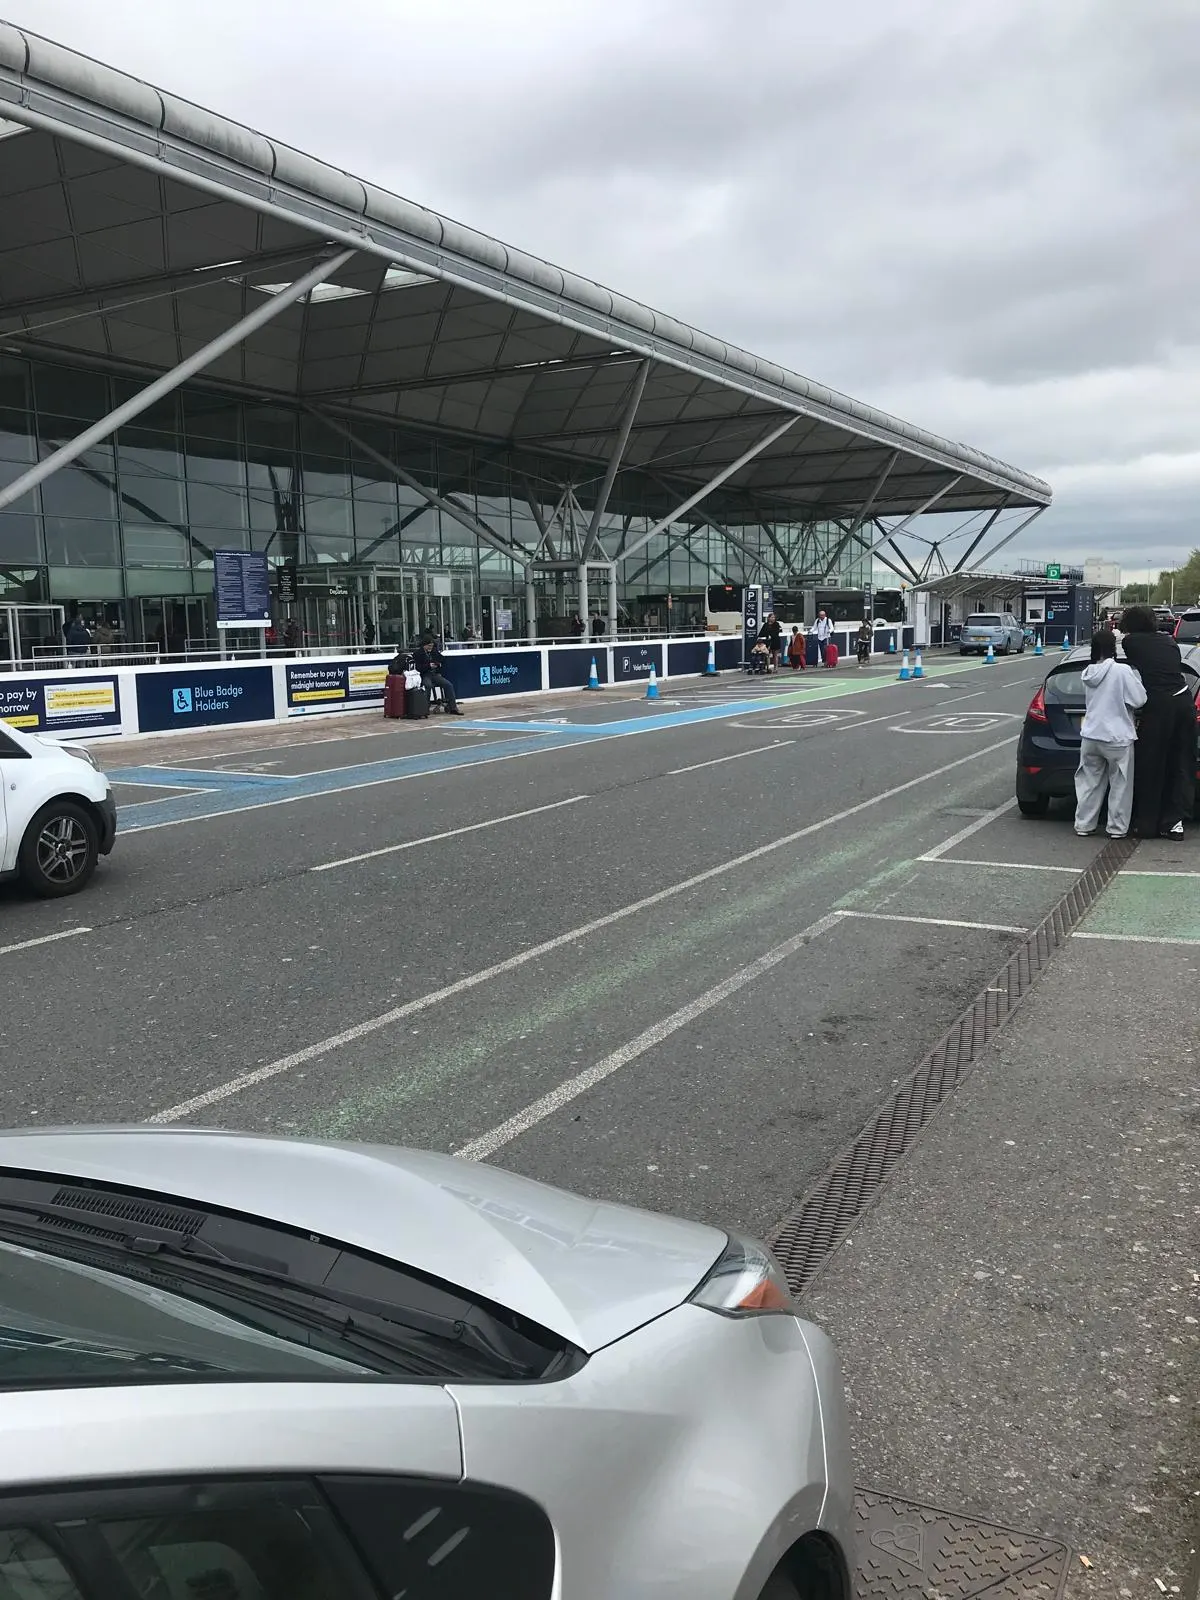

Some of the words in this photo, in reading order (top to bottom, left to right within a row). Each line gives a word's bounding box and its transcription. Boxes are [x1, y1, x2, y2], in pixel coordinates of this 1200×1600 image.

[1050, 569, 1058, 577] D
[747, 591, 755, 601] P
[491, 666, 503, 675] Blue
[503, 665, 519, 675] Badge
[624, 659, 629, 670] P
[290, 670, 319, 680] Remember
[320, 670, 326, 678] to
[326, 671, 337, 680] pay
[337, 668, 345, 679] by
[291, 679, 315, 691] midnight
[315, 680, 340, 688] tomorrow
[492, 675, 511, 685] Holders
[7, 691, 24, 703] pay
[26, 687, 37, 701] by
[194, 686, 214, 698] Blue
[216, 684, 243, 698] Badge
[195, 699, 230, 712] Holders
[767, 713, 838, 724] 10
[928, 717, 998, 728] 10
